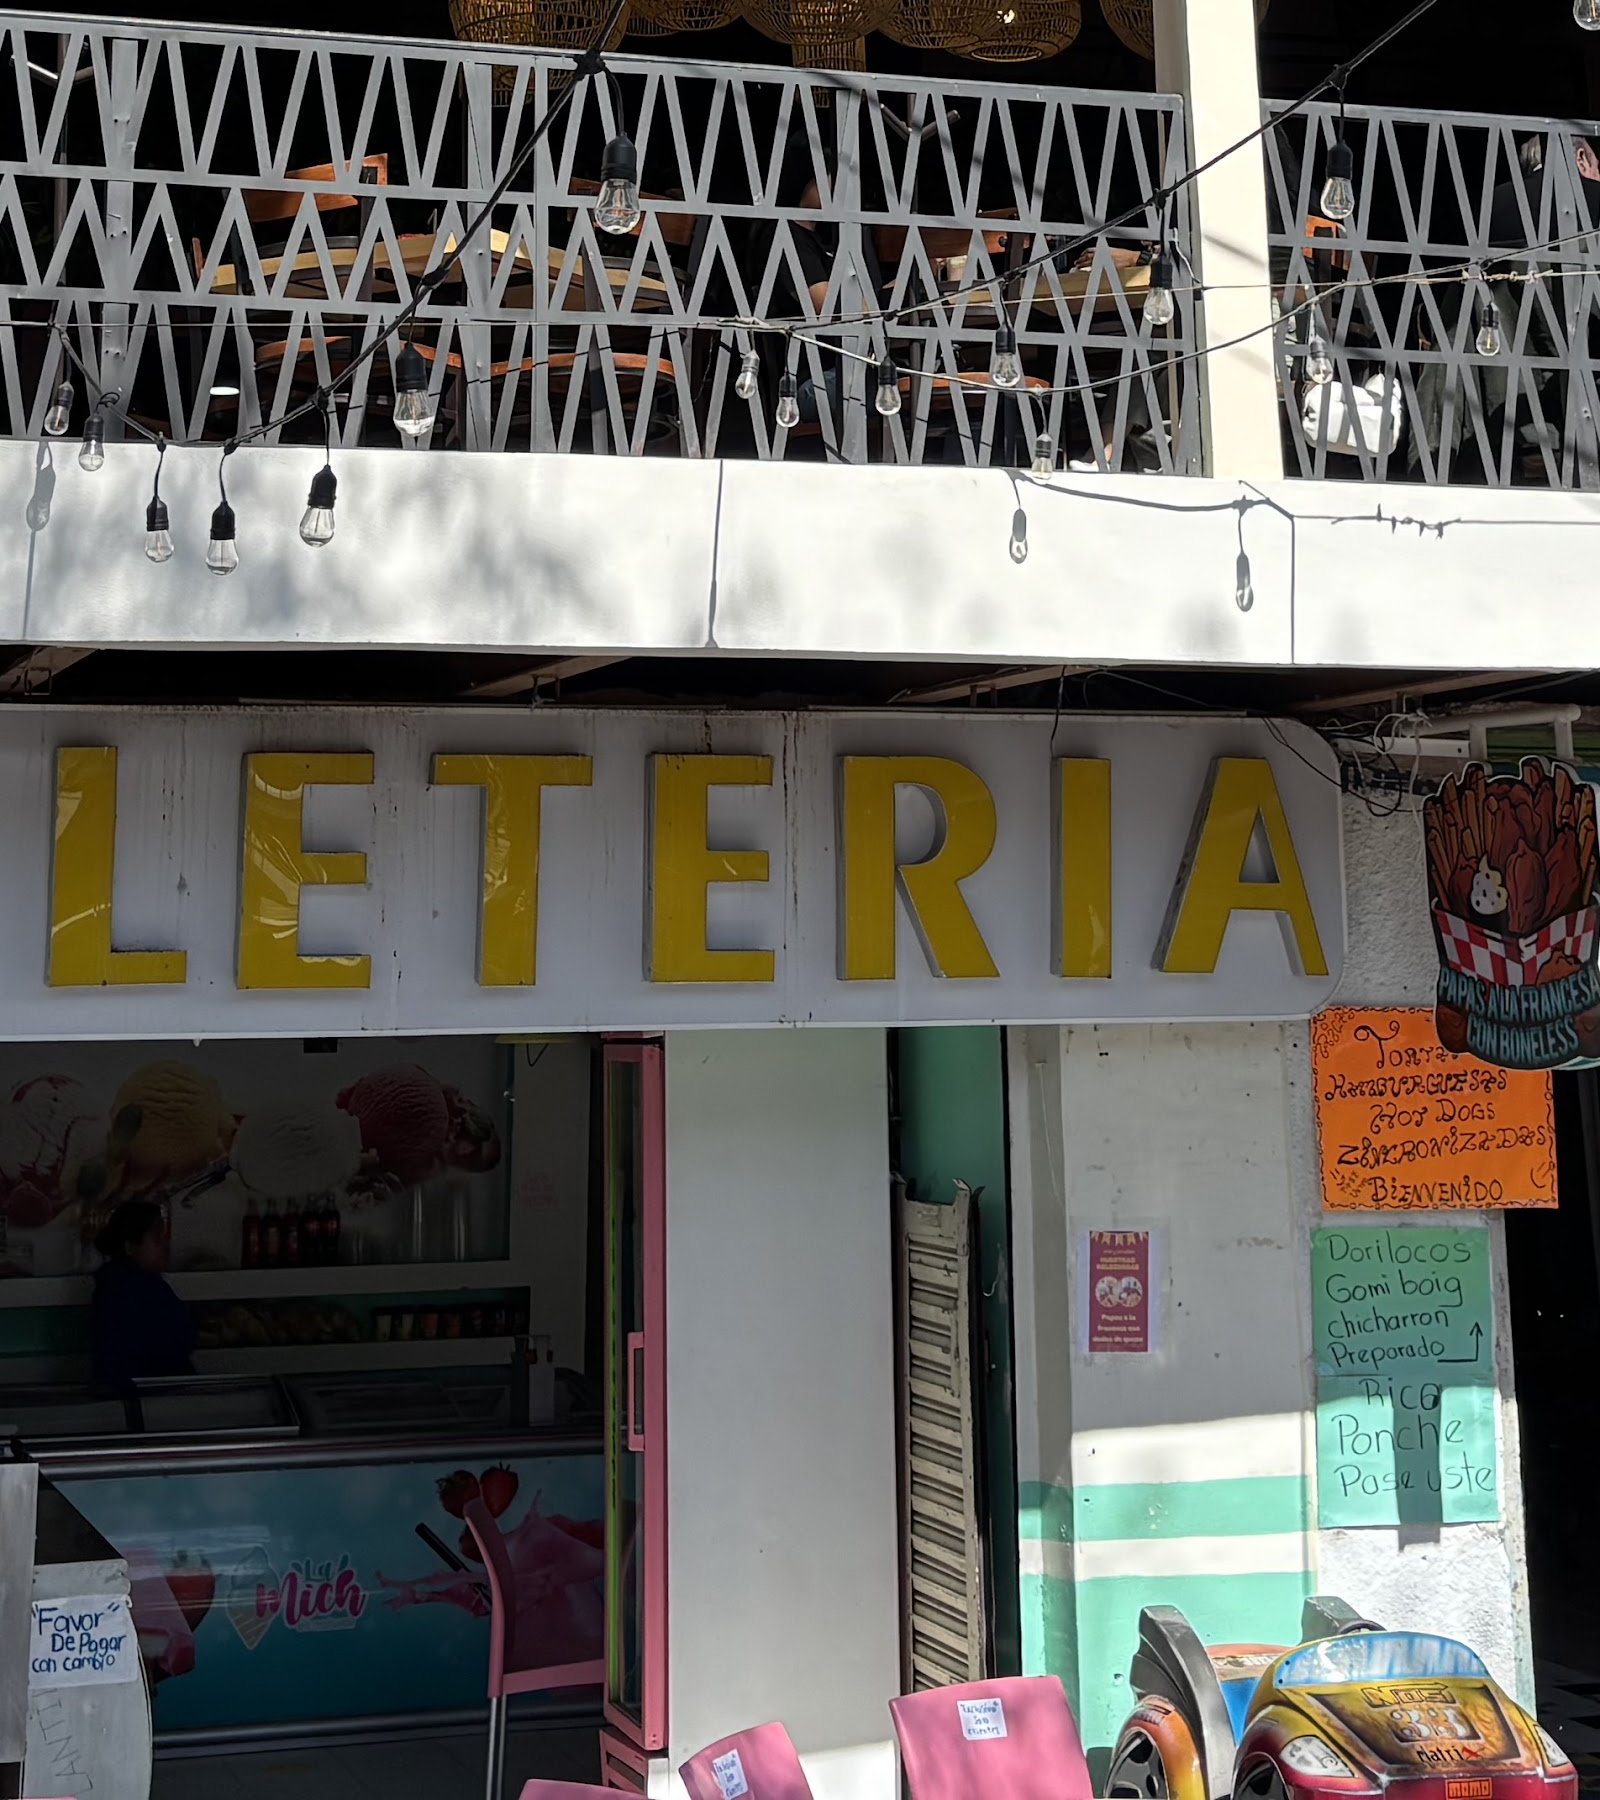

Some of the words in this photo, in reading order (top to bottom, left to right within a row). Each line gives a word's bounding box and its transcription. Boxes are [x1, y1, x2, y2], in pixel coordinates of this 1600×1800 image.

[1440, 966, 1487, 1014] PAPAS
[1488, 984, 1499, 1019] A
[1500, 984, 1519, 1021] LA
[1467, 1013, 1498, 1058] CON
[1500, 1014, 1579, 1064] BONELESS
[1324, 1230, 1471, 1263] Dorilocos
[1325, 1273, 1391, 1303] Gomi
[1327, 1305, 1449, 1339] chicharron
[1331, 1413, 1464, 1456] Ponche
[79, 1632, 127, 1657] Pagar
[32, 1657, 57, 1673] con
